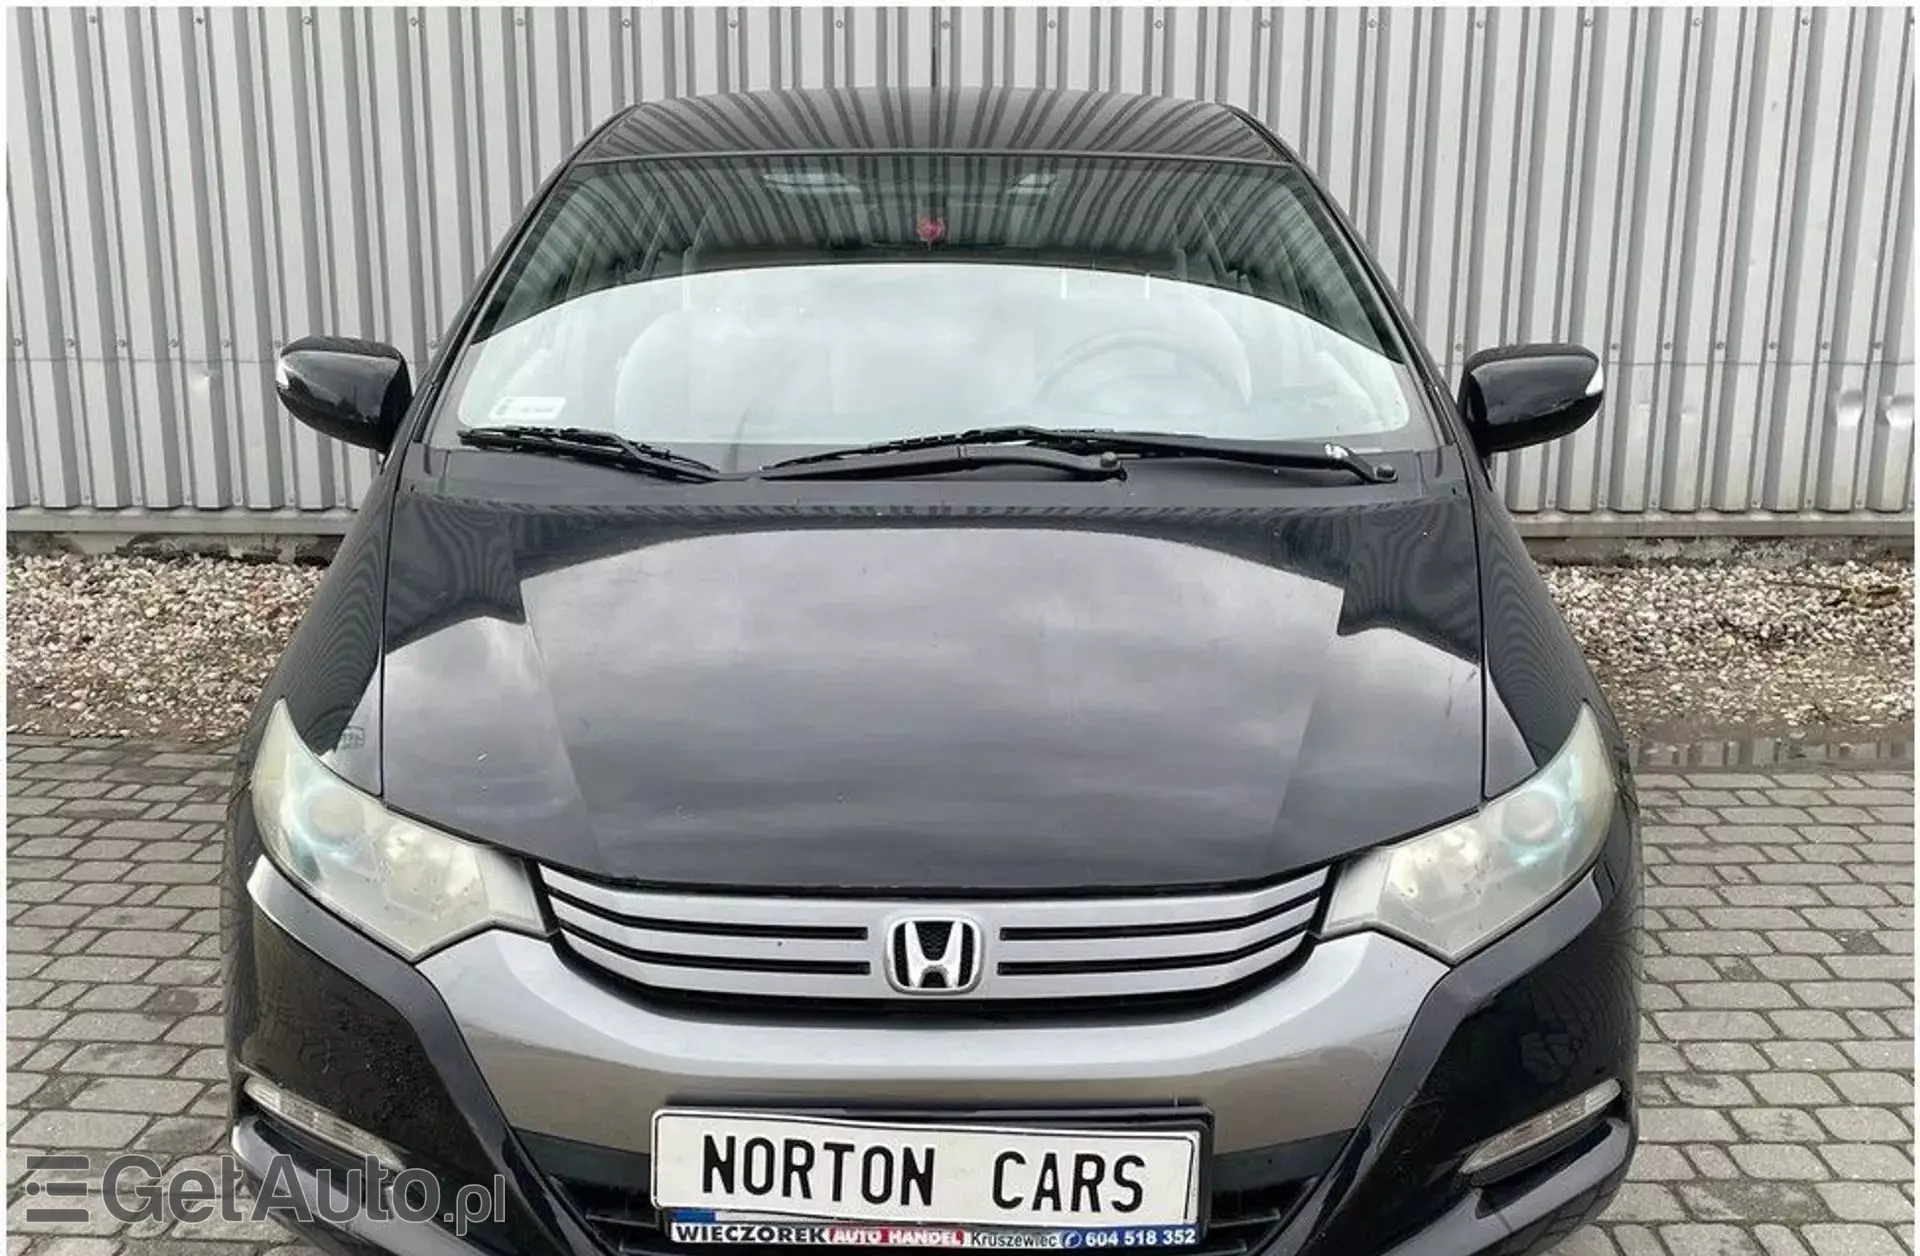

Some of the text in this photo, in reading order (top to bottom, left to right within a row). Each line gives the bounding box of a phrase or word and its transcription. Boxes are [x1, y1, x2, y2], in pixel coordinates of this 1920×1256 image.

[700, 1134, 1147, 1214] NORTON CARS
[675, 1224, 1197, 1248] WIECZOREK AUTO HANDEL Kruszewiec 604 518 352
